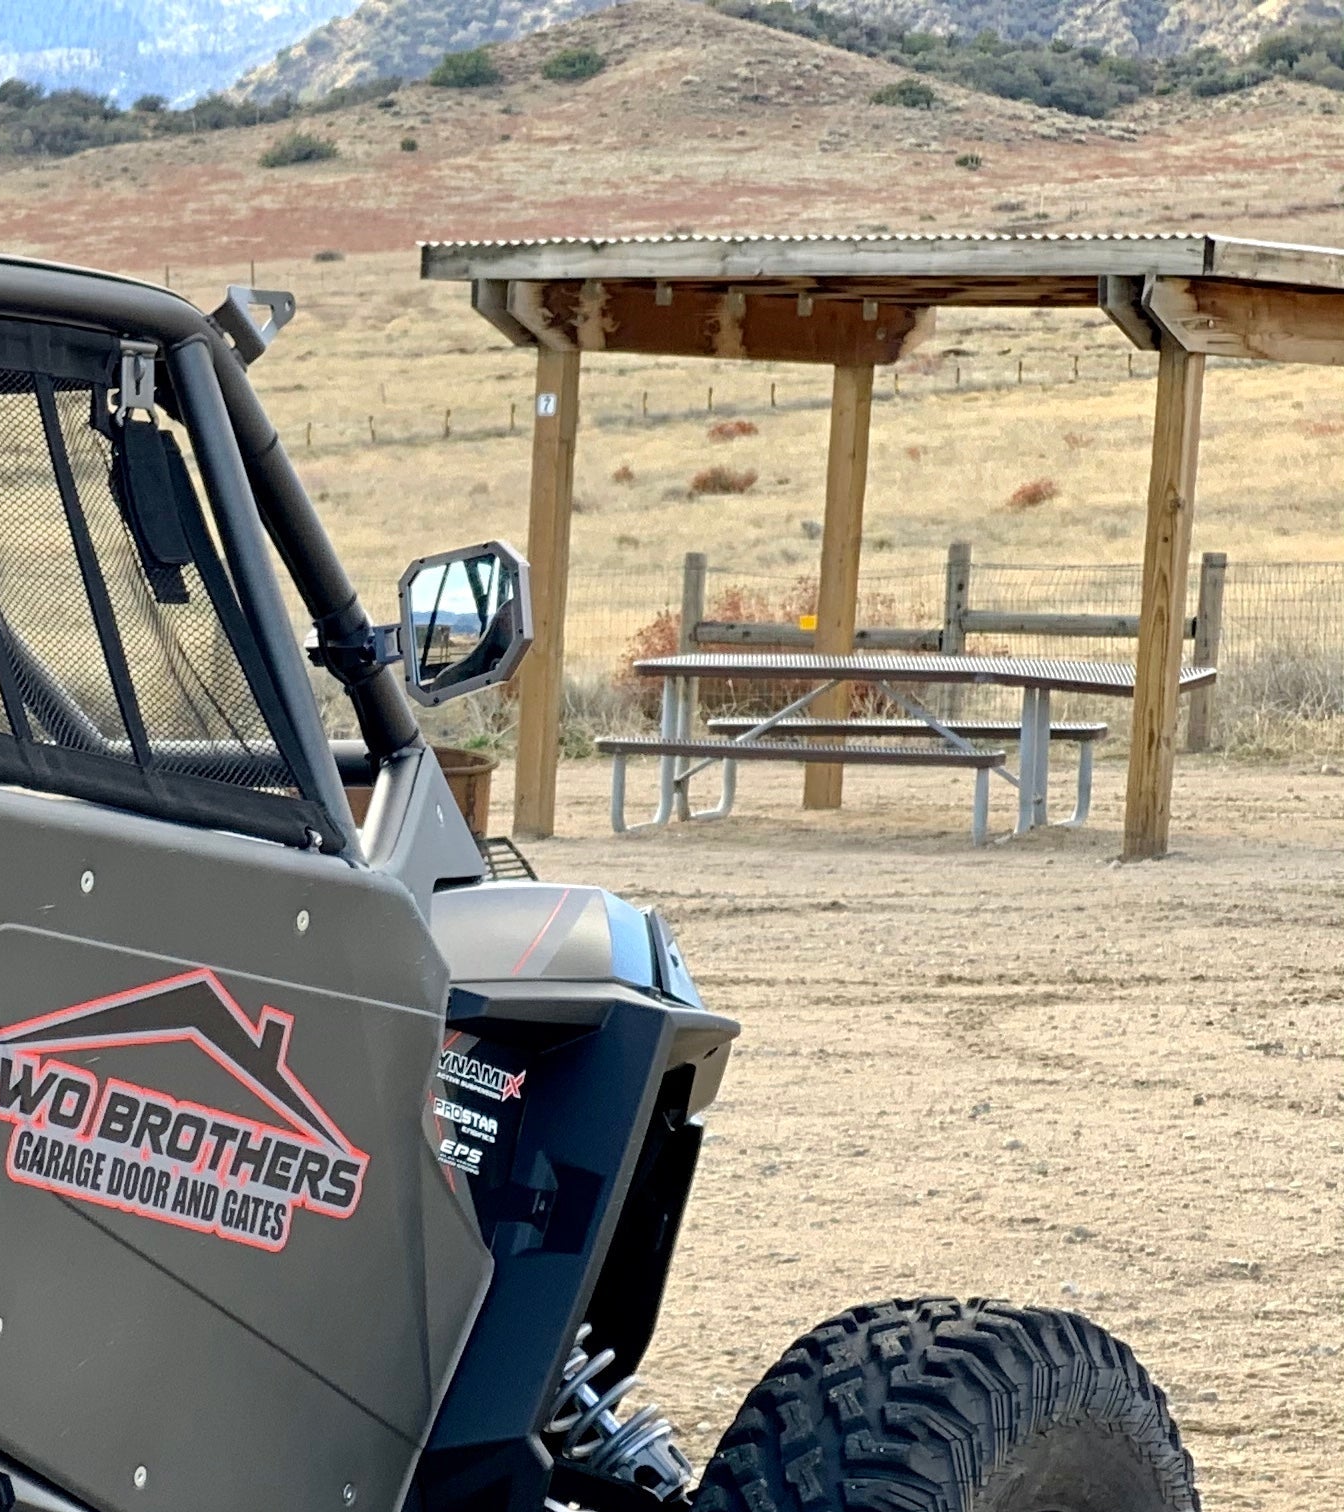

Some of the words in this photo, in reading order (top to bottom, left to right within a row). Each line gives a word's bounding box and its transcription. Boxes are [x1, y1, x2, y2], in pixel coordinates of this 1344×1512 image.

[543, 396, 552, 412] 7
[438, 1050, 526, 1102] YNAMIX
[433, 1097, 499, 1136] PROSTAR
[98, 1091, 360, 1208] BROTHERS
[440, 1139, 483, 1164] EPS
[13, 1130, 112, 1192] GARAGE
[111, 1157, 169, 1205] DOOR
[171, 1173, 217, 1223] AND
[220, 1189, 287, 1242] GATES
